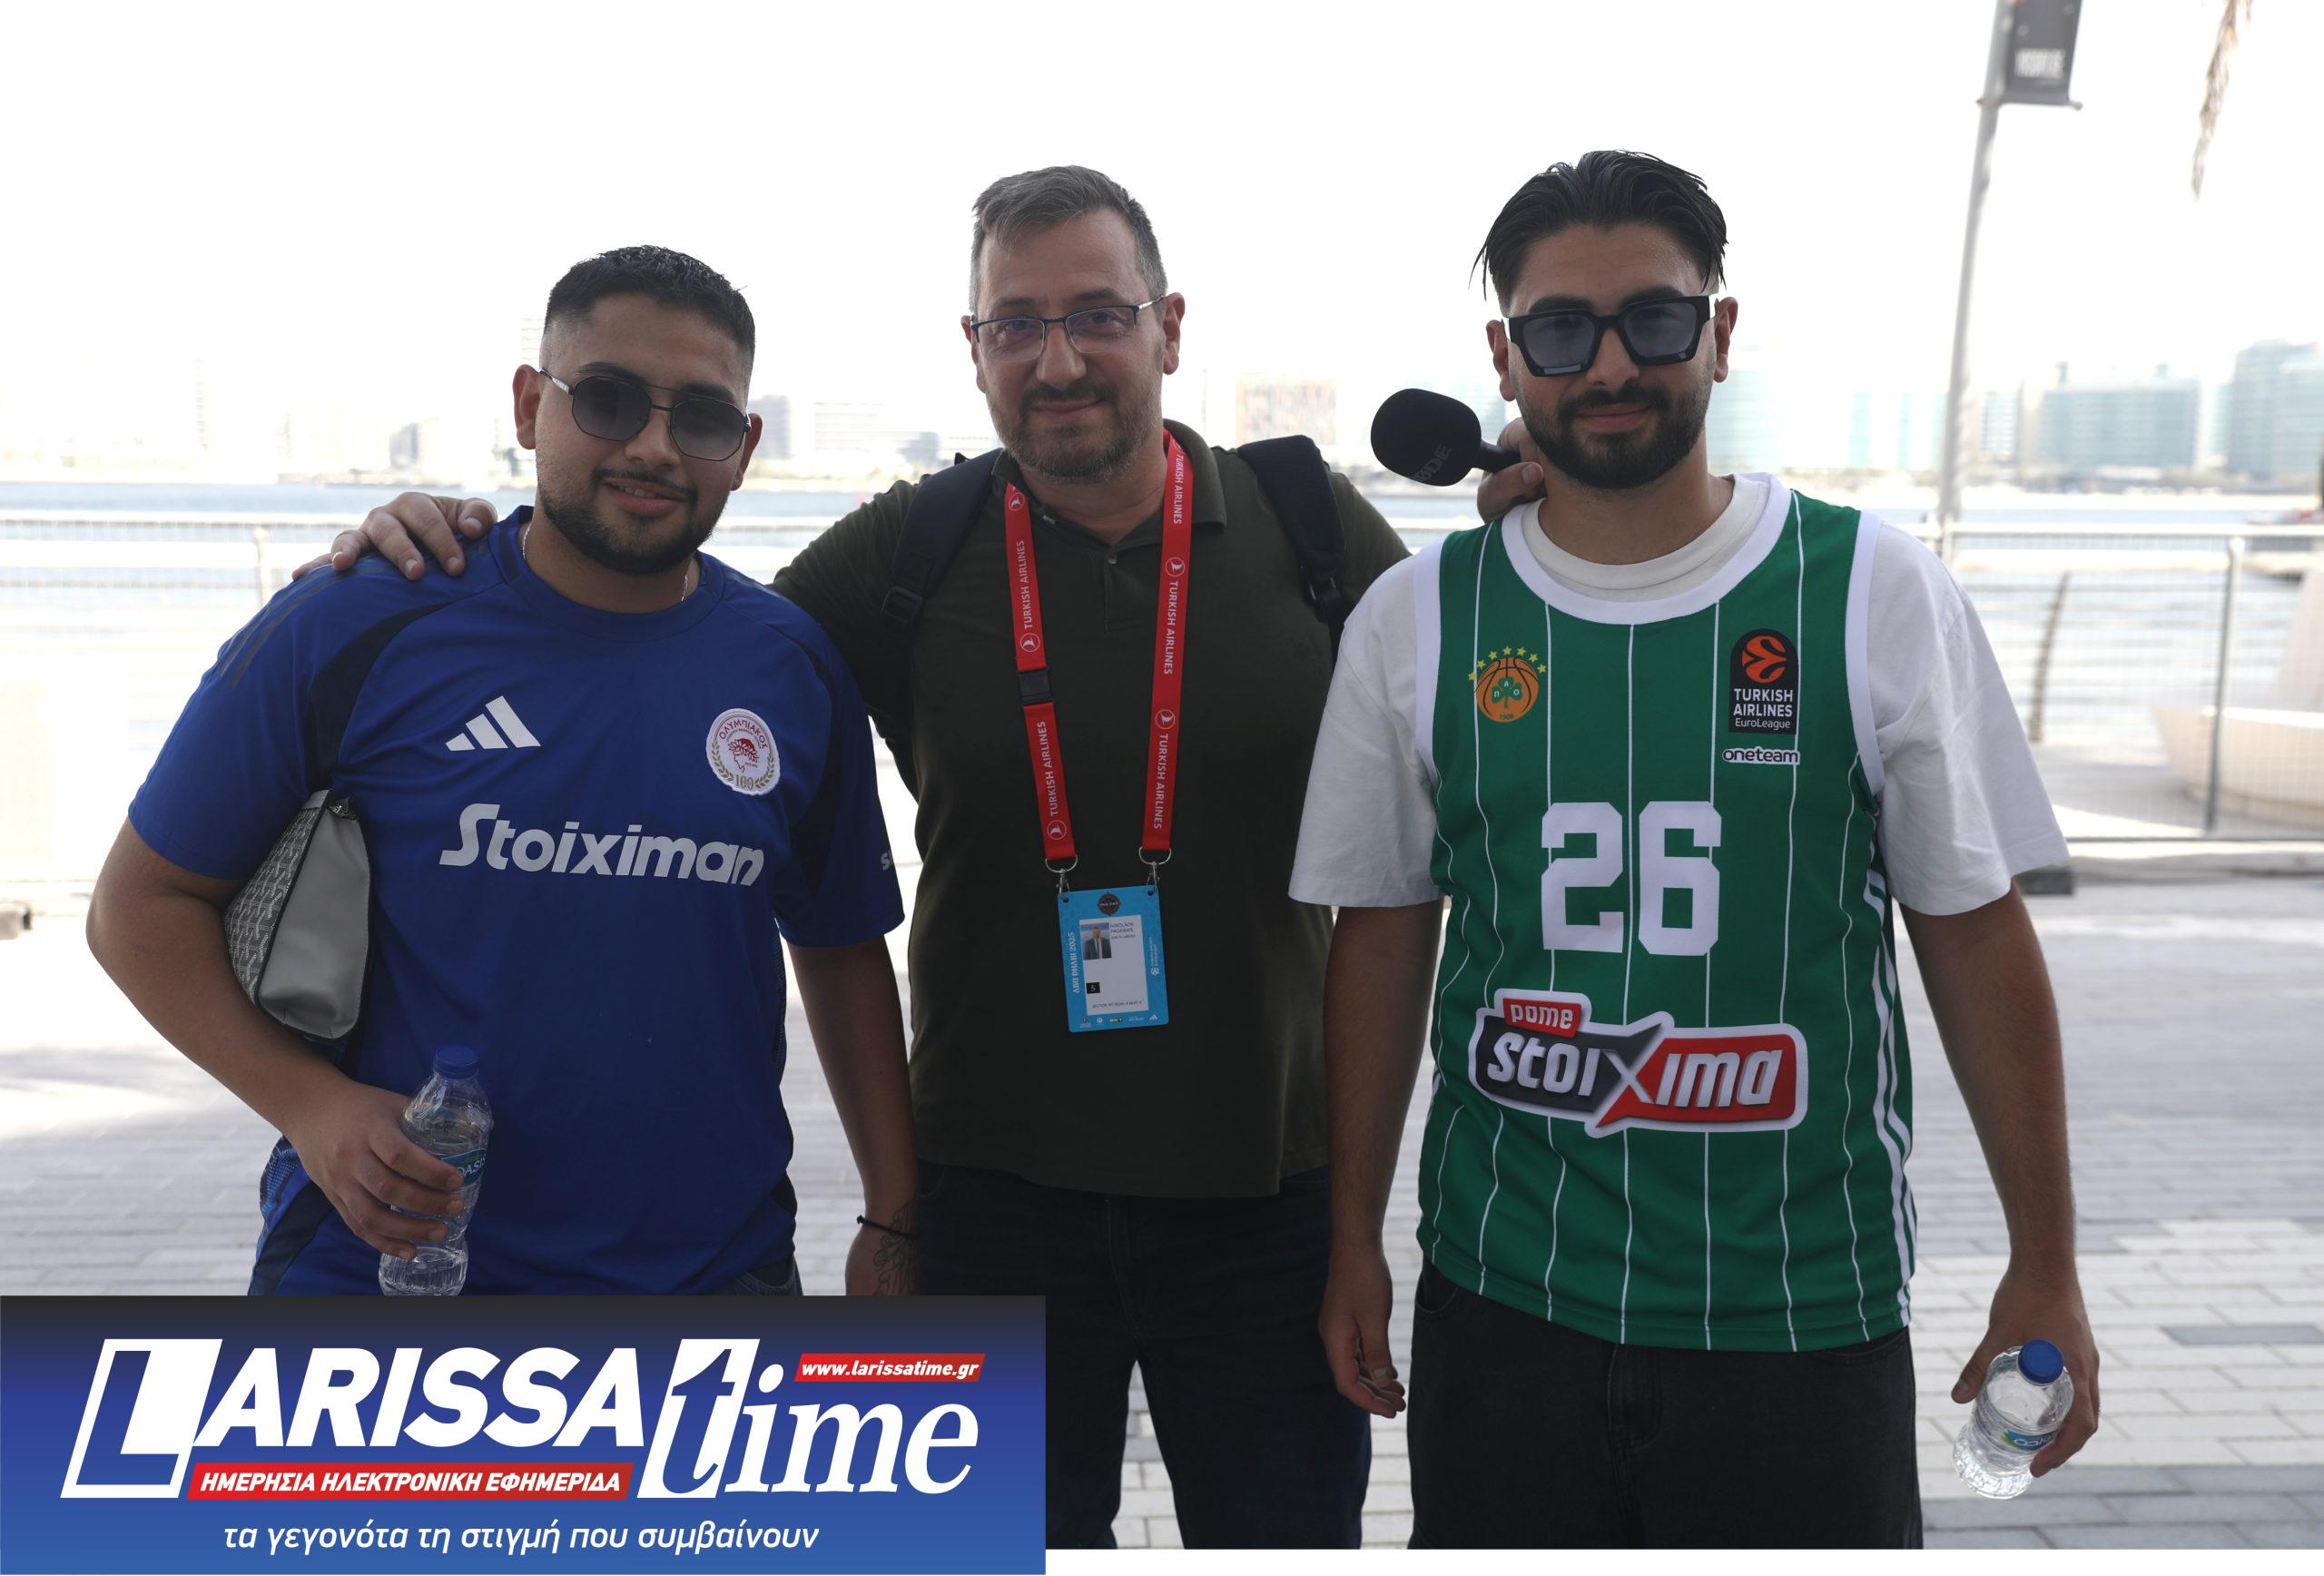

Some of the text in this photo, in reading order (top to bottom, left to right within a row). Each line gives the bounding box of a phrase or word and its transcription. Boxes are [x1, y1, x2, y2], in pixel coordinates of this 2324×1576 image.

[1173, 454, 1184, 524] TURKISH AIRLINES
[1017, 540, 1033, 630] TURKISH AIRLINES
[1163, 581, 1178, 675] TURKISH AIRLINES
[1733, 704, 1793, 717] AIRLINES
[1734, 688, 1793, 703] TURKISH
[1735, 717, 1791, 730] EuroLeague
[1037, 721, 1059, 817] TURKISH AIRLINES
[1153, 734, 1168, 829] TURKISH AIRLINES
[1723, 747, 1798, 763] oneteam
[438, 803, 764, 887] Stoiximan
[1541, 801, 1722, 957] 26
[1068, 931, 1080, 994] ABU DHABI 2025
[1510, 1002, 1573, 1030] pame
